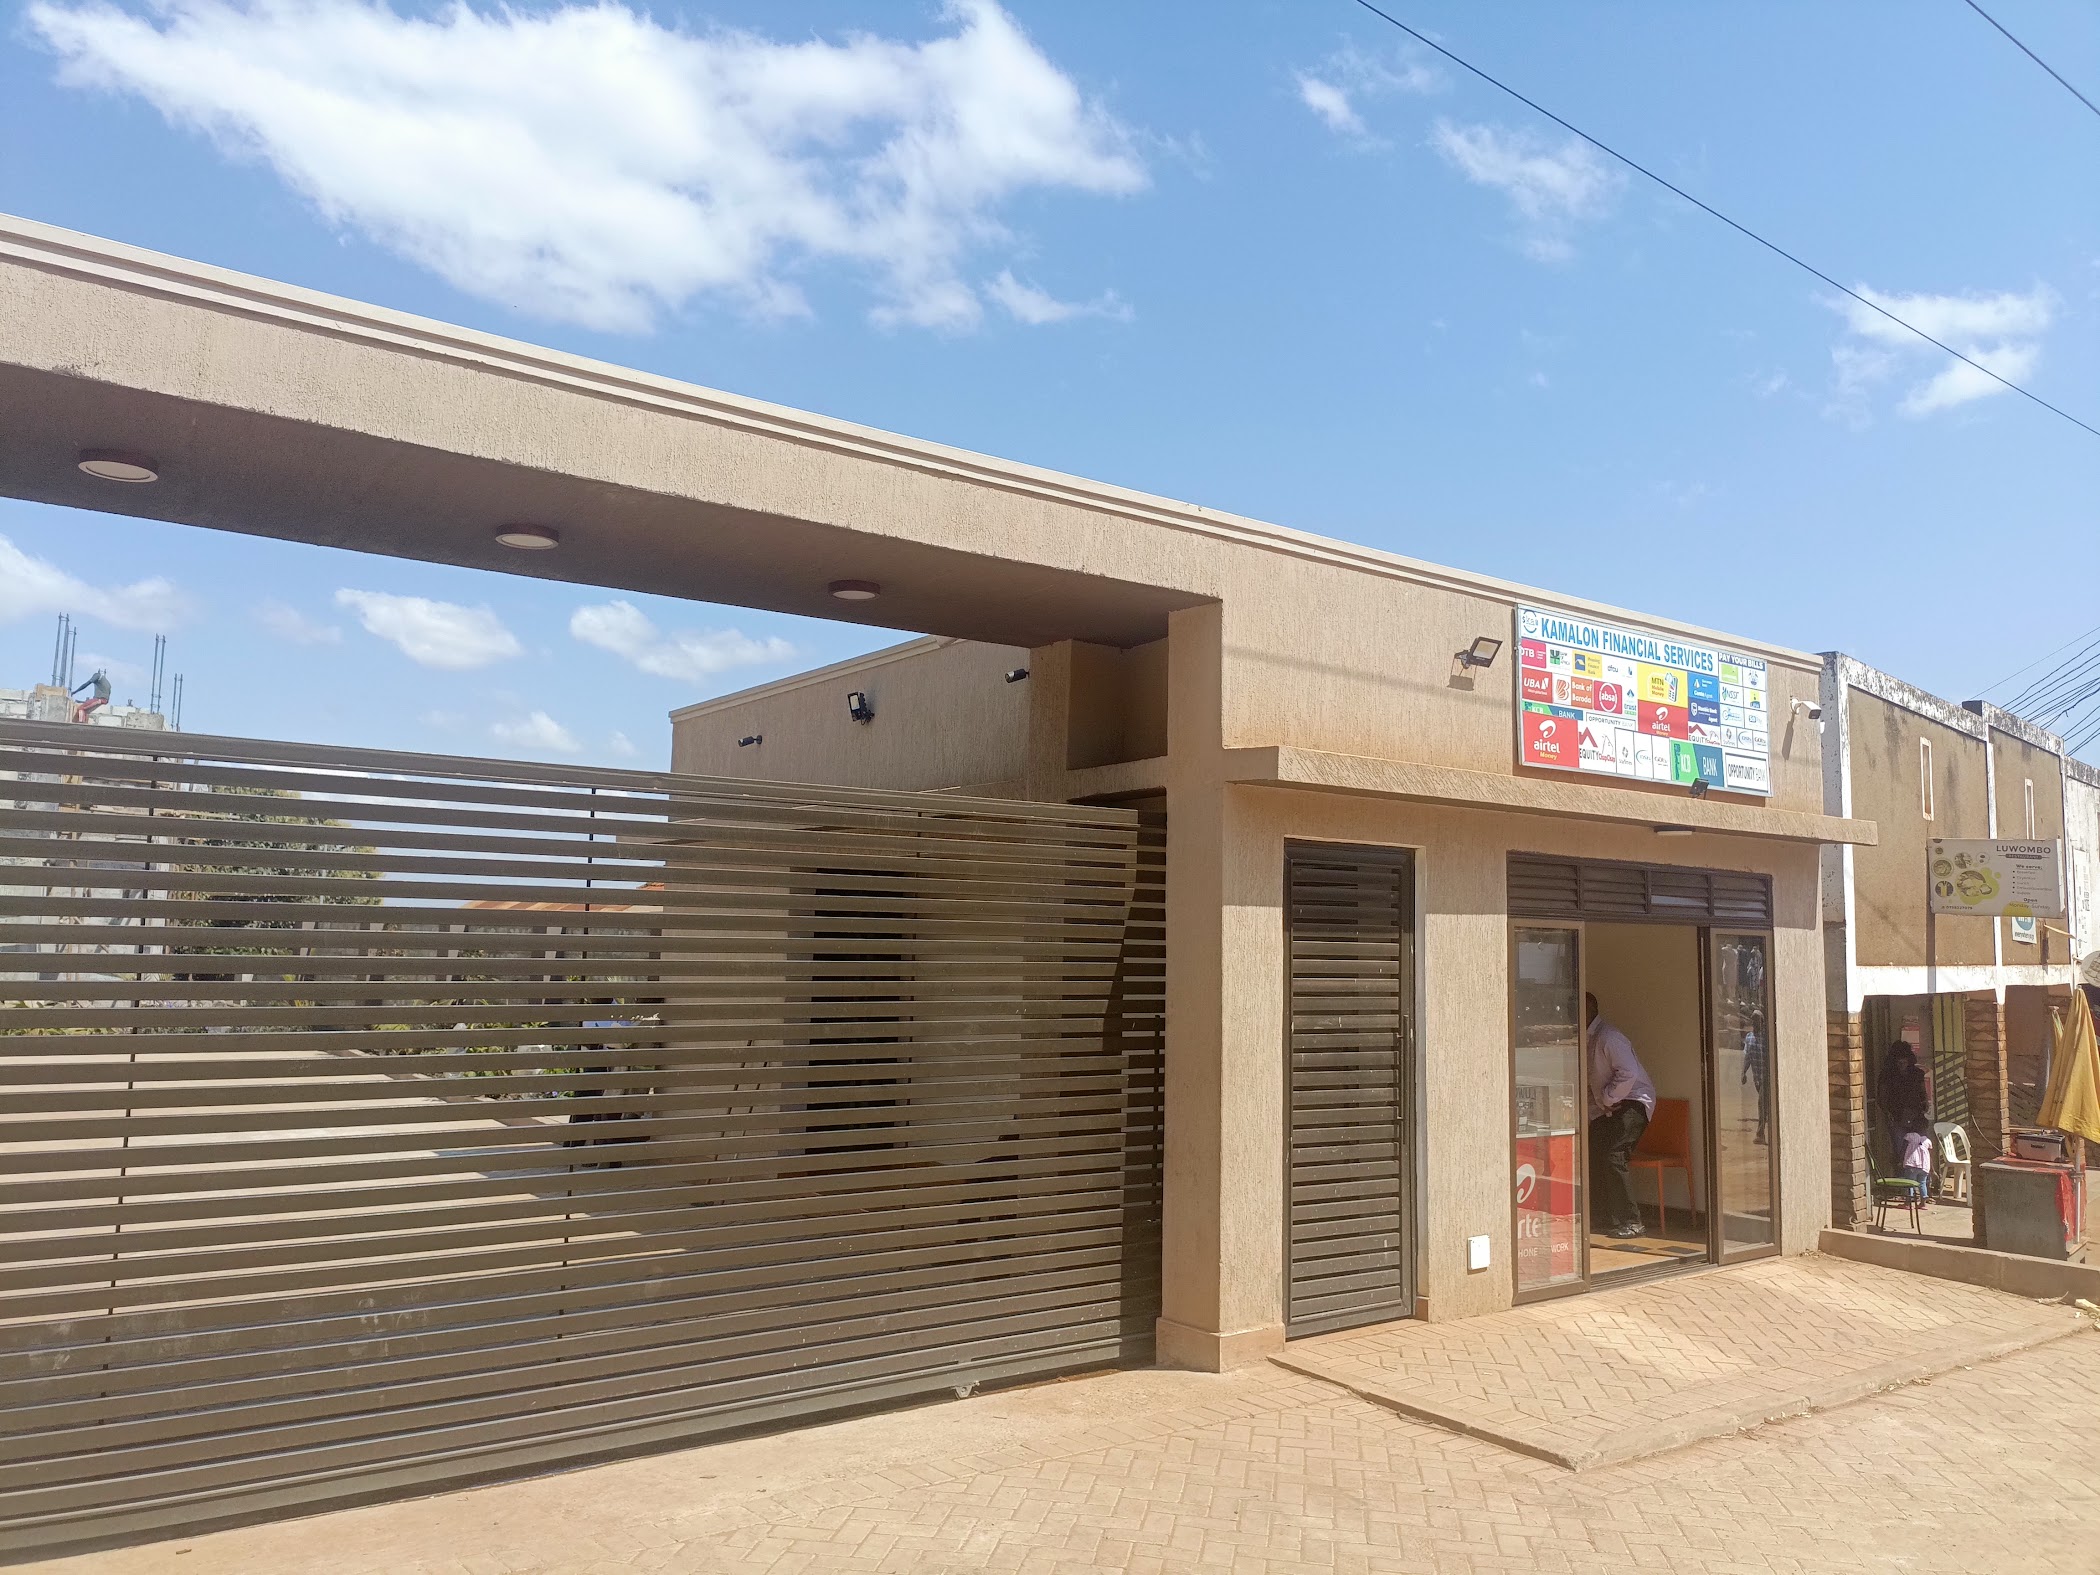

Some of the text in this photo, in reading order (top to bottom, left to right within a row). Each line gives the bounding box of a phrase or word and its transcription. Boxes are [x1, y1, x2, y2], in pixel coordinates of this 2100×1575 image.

[1541, 617, 1713, 672] KAMALON FINANCIAL SERVICES
[1719, 652, 1763, 670] PAY YOUR BILLS
[1523, 677, 1541, 690] UBA
[1571, 681, 1593, 692] Bank of
[1651, 677, 1665, 686] MTN
[1571, 693, 1592, 704] Baroda
[1600, 690, 1616, 702] absa
[1558, 710, 1576, 719] BANK
[1588, 715, 1621, 727] OPPORTUNITY
[1651, 720, 1671, 732] airtel
[1688, 734, 1708, 744] EQUITY
[1533, 738, 1561, 754] airtel
[1539, 751, 1558, 761] Money
[1579, 747, 1600, 761] EQUITY
[1680, 753, 1691, 773] KCB
[1702, 756, 1718, 777] BANK
[1727, 763, 1755, 780] OPPORTUNITY
[1996, 845, 2051, 854] LUWOMBO
